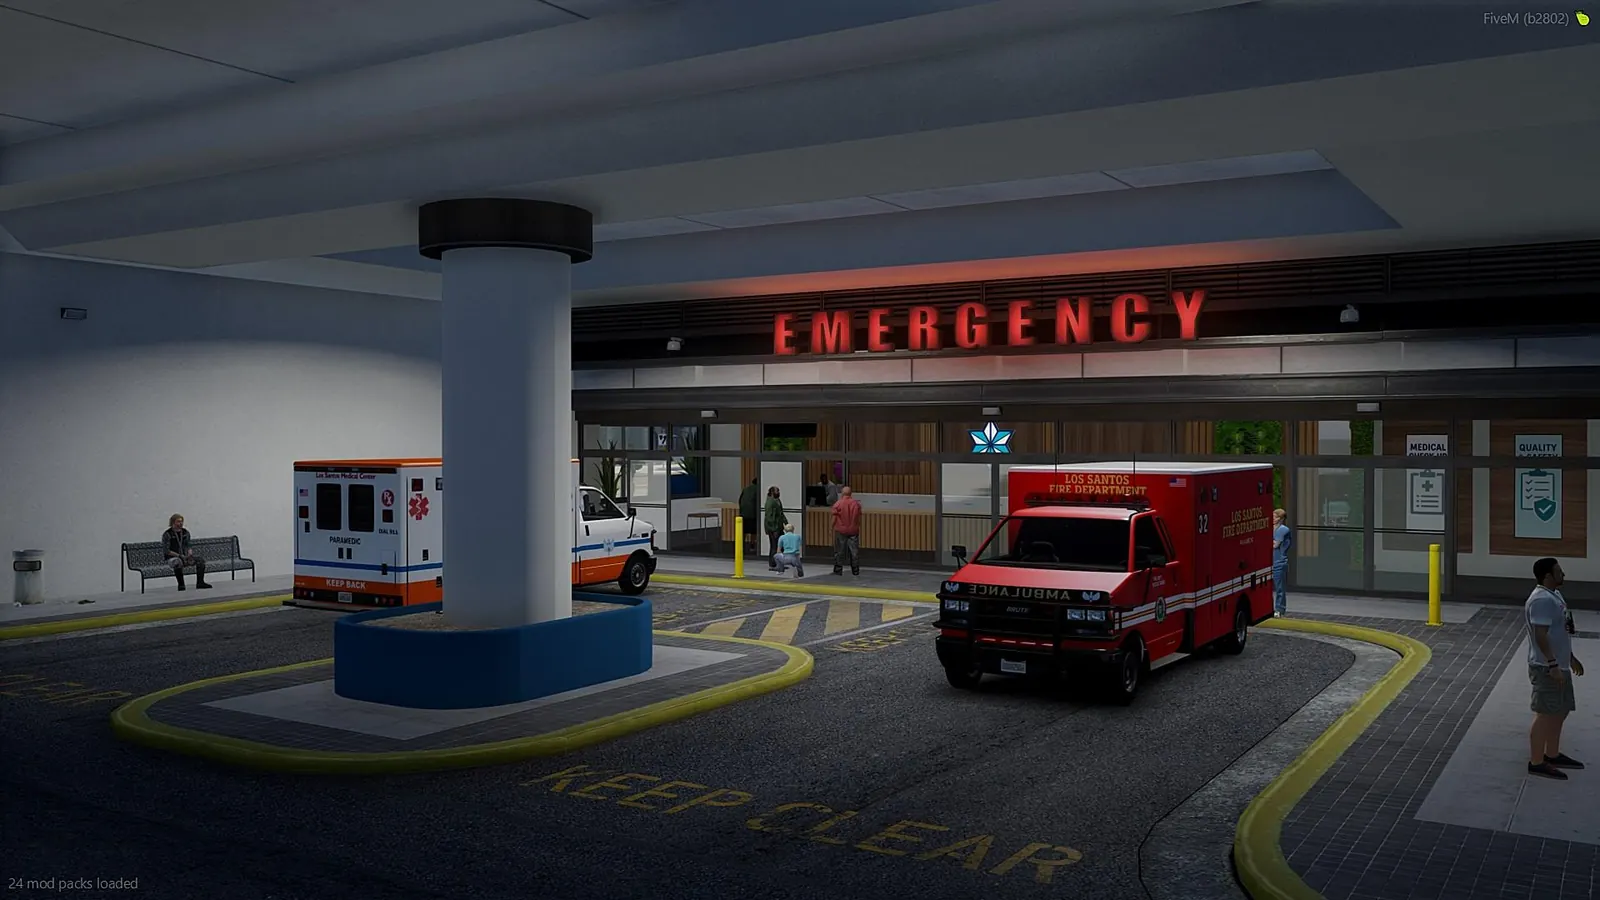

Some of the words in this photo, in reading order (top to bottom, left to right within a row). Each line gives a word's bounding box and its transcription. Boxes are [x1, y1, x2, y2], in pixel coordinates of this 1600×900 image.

[773, 289, 1207, 356] EMERGENCY
[1410, 443, 1446, 451] MEDICAL
[1519, 443, 1557, 452] QUALITY
[1064, 474, 1085, 484] LOS
[1087, 474, 1130, 485] SANTOS
[1049, 484, 1072, 494] FIRE
[1074, 485, 1148, 496] DEPARTMENT
[1198, 513, 1209, 534] 32
[329, 535, 361, 545] PARAMEDIC
[326, 579, 345, 588] KEEP
[346, 580, 367, 590] BACK
[519, 765, 755, 815] KEEP
[745, 802, 1085, 884] CLEAR
